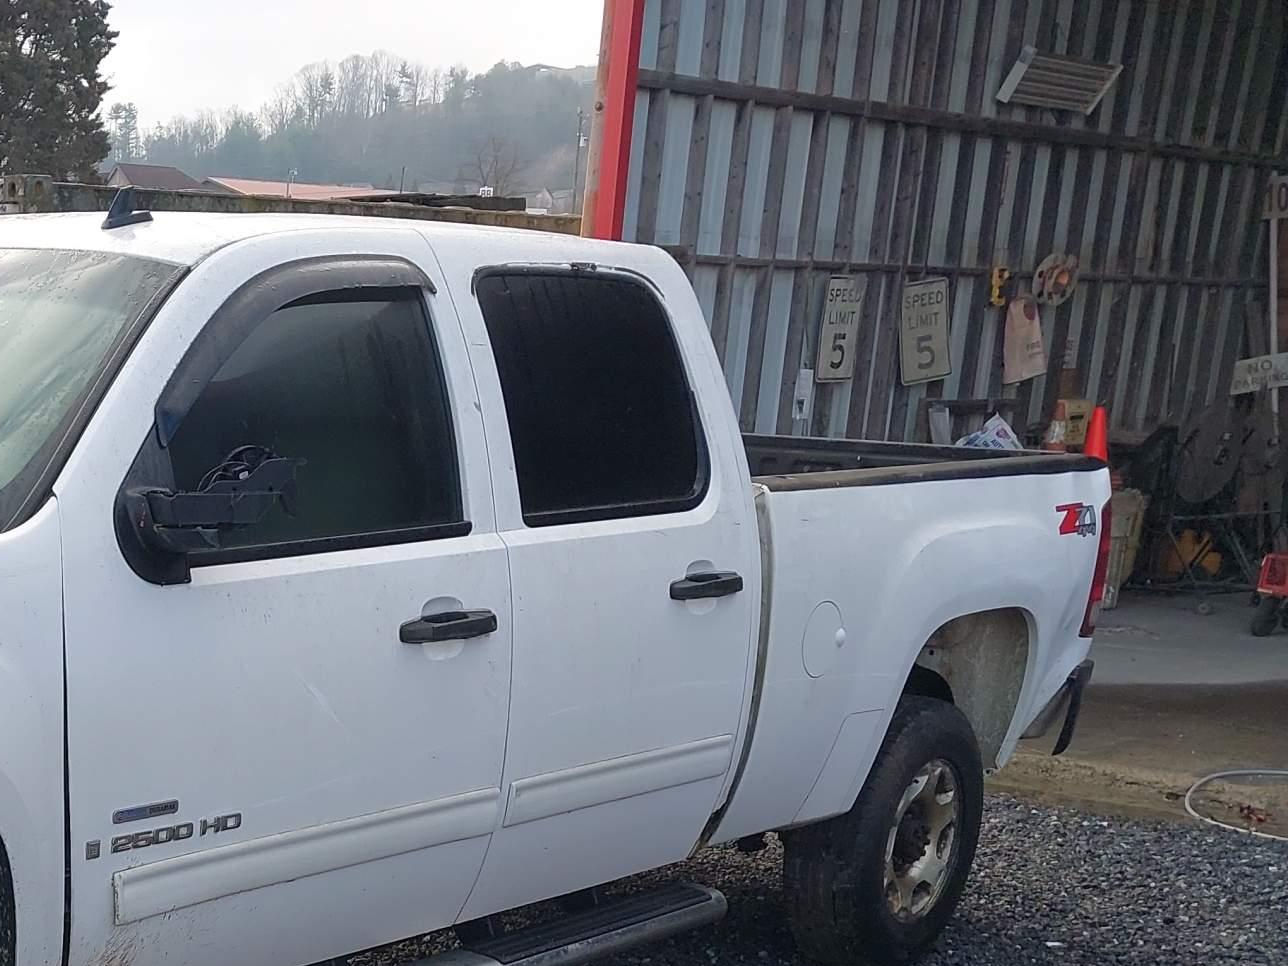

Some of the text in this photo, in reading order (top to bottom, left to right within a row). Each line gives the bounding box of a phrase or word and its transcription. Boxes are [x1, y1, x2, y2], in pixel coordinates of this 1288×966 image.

[829, 288, 862, 303] SPEED
[904, 290, 944, 310] SPEED
[829, 311, 856, 325] LIMIT
[908, 312, 940, 330] LIMIT
[829, 333, 847, 370] 5
[916, 334, 936, 370] 5
[1247, 359, 1272, 375] NO
[111, 822, 194, 854] 2500
[200, 813, 242, 836] HD
